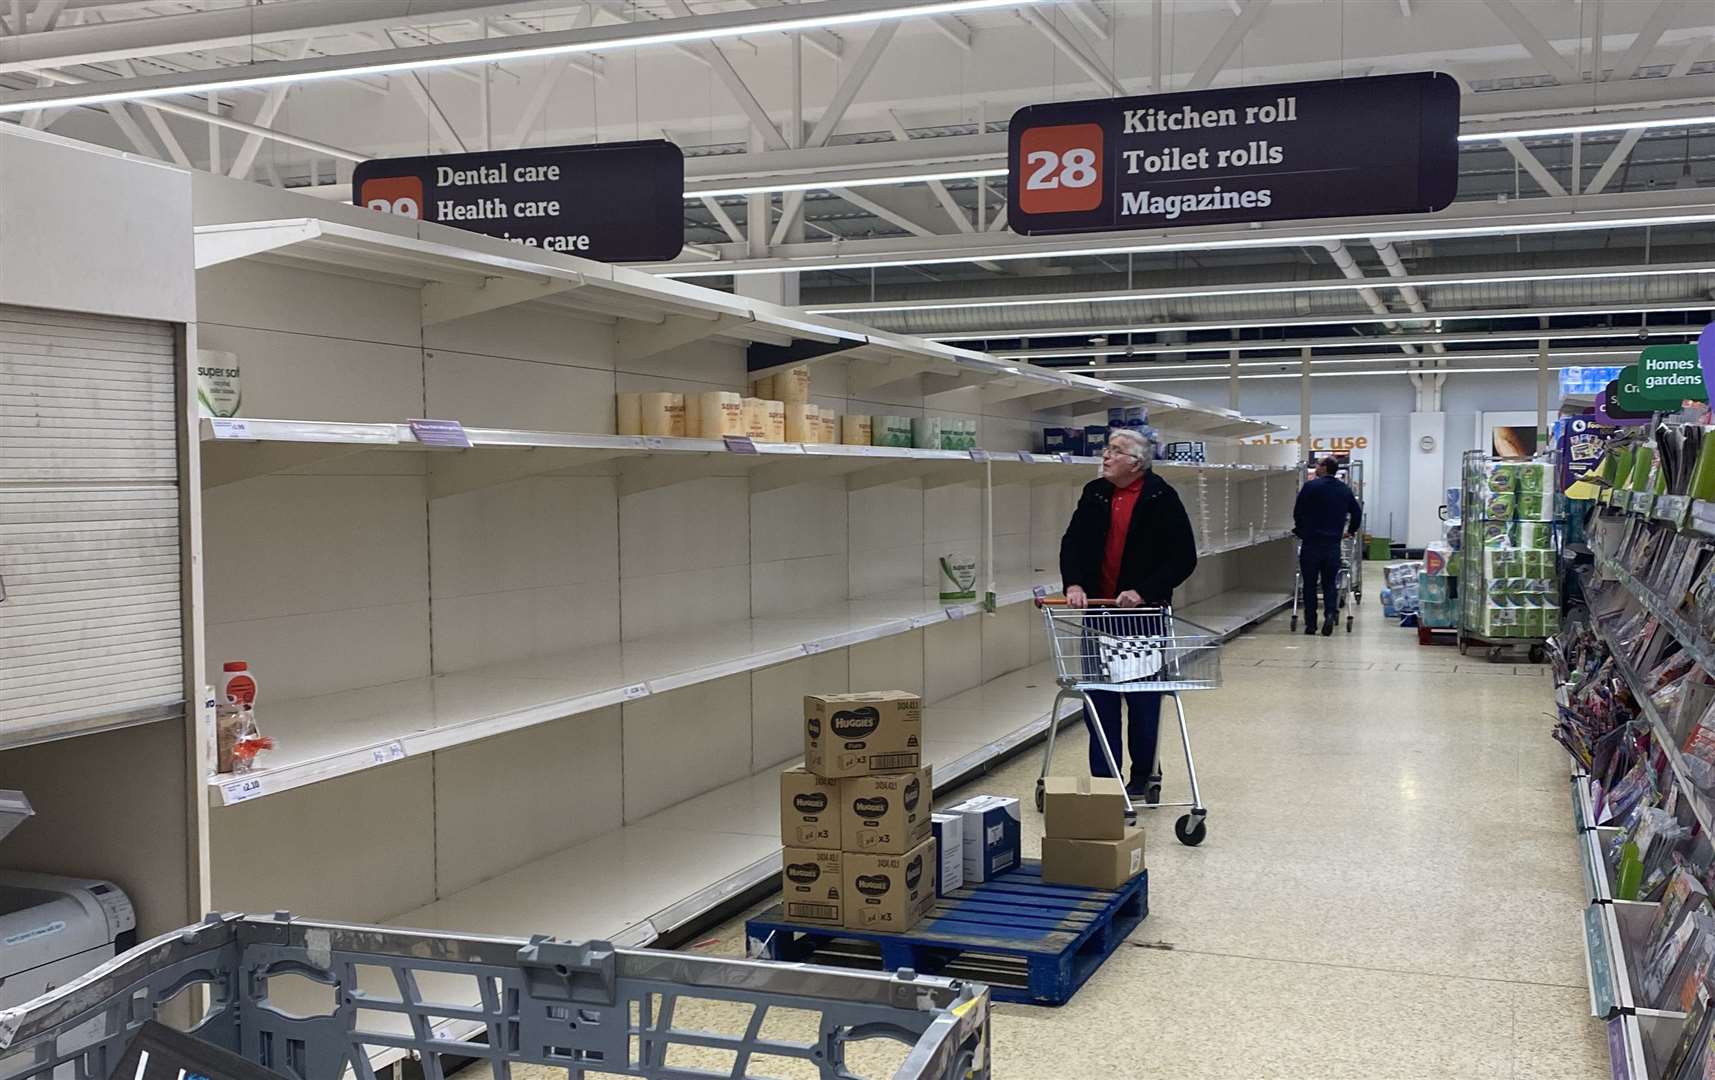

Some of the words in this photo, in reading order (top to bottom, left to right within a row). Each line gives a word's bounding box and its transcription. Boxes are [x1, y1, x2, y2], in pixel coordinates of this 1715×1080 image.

[1123, 105, 1236, 134] Kitchen
[1245, 97, 1297, 123] roll
[1123, 146, 1209, 174] Toilet
[1217, 142, 1283, 167] rolls
[436, 163, 508, 187] Dental
[513, 165, 560, 182] care
[1026, 147, 1097, 190] 28
[436, 198, 508, 221] Health
[513, 201, 560, 217] care
[1121, 187, 1271, 220] Magazines
[543, 235, 590, 251] care
[197, 366, 224, 379] super
[1645, 359, 1694, 371] Homes
[1645, 373, 1702, 389] gardens
[1330, 435, 1368, 450] use
[835, 718, 874, 729] HUGGIES
